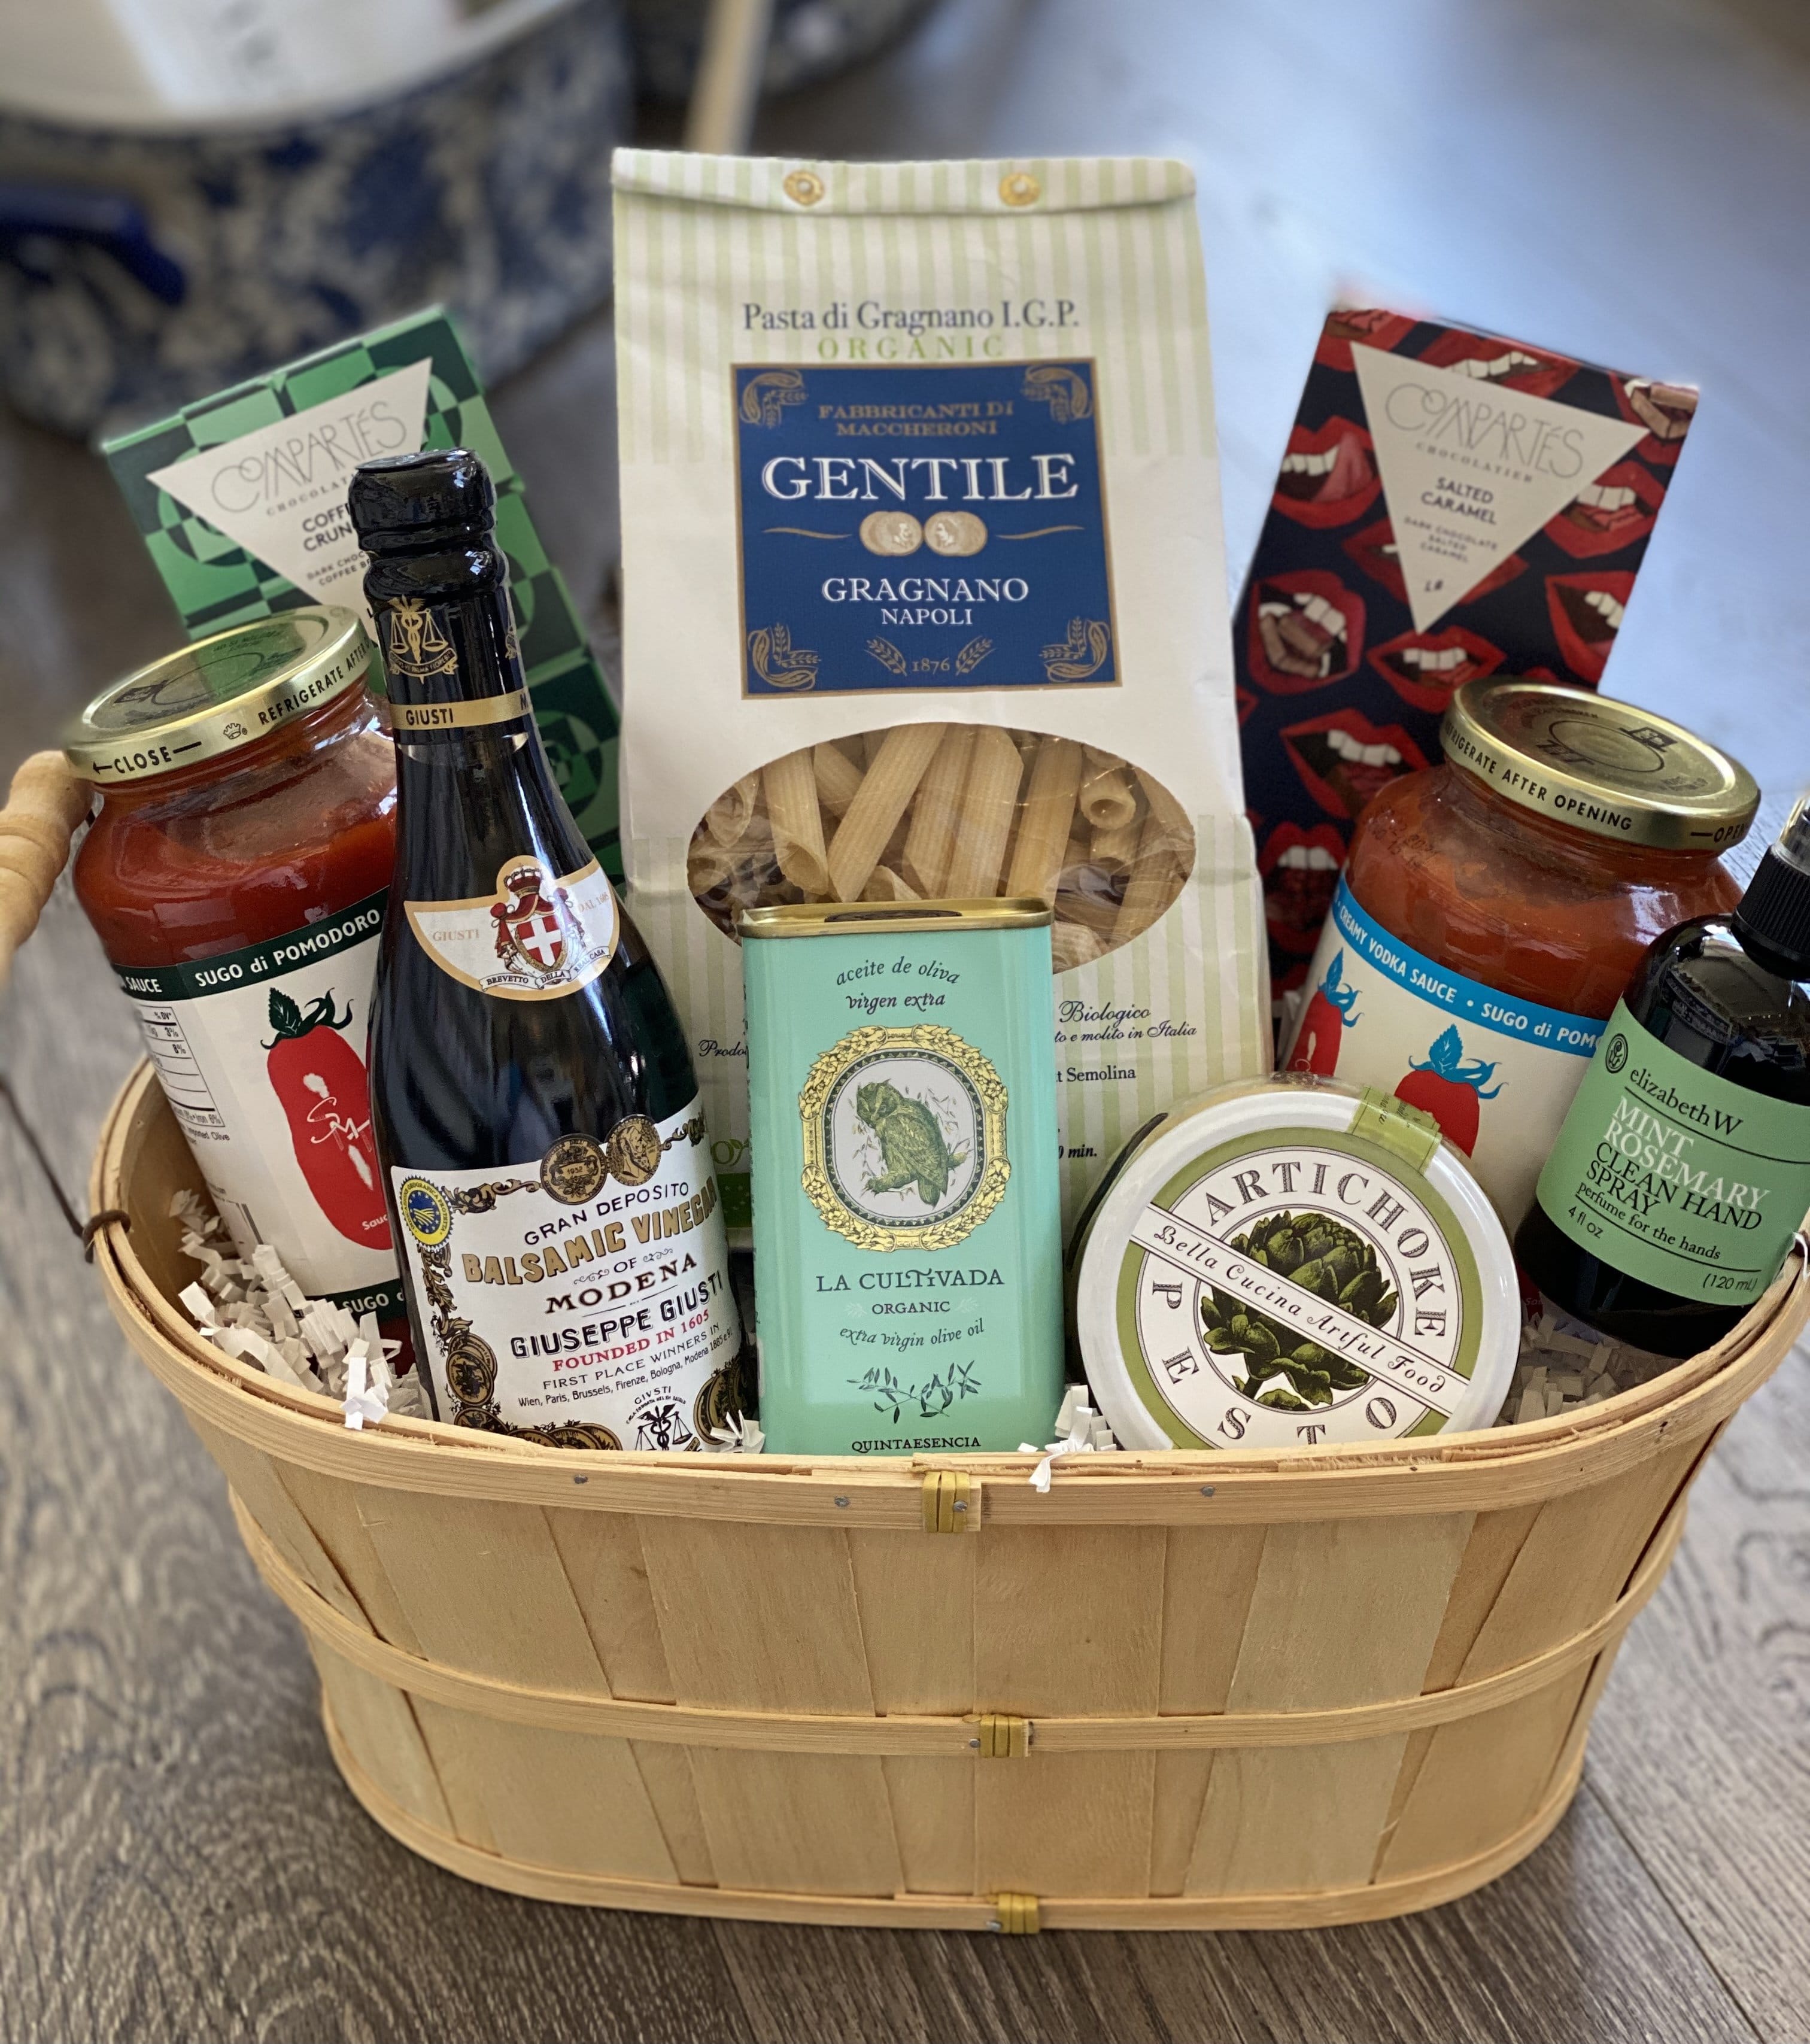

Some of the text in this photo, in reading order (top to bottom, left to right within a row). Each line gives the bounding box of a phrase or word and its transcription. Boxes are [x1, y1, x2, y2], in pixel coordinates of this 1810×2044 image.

[743, 300, 1080, 336] Pasta di Gragnano I.G.P.
[817, 335, 1003, 360] ORGANIC
[818, 403, 982, 420] FABBRICANTI
[836, 420, 998, 437] MACCHERONI
[761, 452, 1079, 500] GENTILE
[1415, 441, 1533, 484] CHOCOLATIER
[266, 474, 356, 517] CHOCOLAT
[1435, 476, 1494, 505] SALTED
[1420, 491, 1498, 526] CARAMEL
[306, 565, 334, 581] DARK
[318, 564, 358, 587] COFFEE
[821, 578, 1029, 602] GRAGNANO
[880, 608, 974, 626] NAPOLI
[911, 658, 952, 674] 1876
[257, 665, 345, 727] REFRIGERATE
[406, 708, 455, 726] GIUSTI
[113, 745, 173, 775] CLOSE
[1443, 720, 1497, 776] REFRIGERATE
[1501, 767, 1549, 801] AFTER
[1554, 794, 1633, 831] OPENING
[125, 909, 381, 993] SAUCE SUGO di POMODORO
[432, 928, 479, 943] GIUSTI
[486, 975, 530, 986] BREVETTO
[540, 970, 566, 983] DELLA
[589, 949, 606, 960] CASA
[836, 955, 961, 986] aceite de oliva
[1339, 904, 1368, 946] CREAMY
[1368, 940, 1407, 979] VODKA
[1409, 968, 1458, 1004] SAUCE
[1480, 1001, 1529, 1031] SUGO
[1533, 1022, 1552, 1039] di
[845, 992, 946, 1016] virgen extra
[1058, 1000, 1152, 1029] Biologico
[1080, 1025, 1125, 1042] molito
[1128, 1026, 1144, 1039] in
[1146, 1019, 1198, 1038] Italia
[698, 1038, 748, 1058] Prodo
[1066, 1064, 1137, 1083] Semolina
[210, 1131, 230, 1141] Olive
[1611, 1095, 1695, 1159] MINT
[1067, 1143, 1098, 1159] min.
[1603, 1118, 1771, 1211] ROSEMARY
[1586, 1159, 1661, 1217] SPRAY
[1596, 1142, 1762, 1231] CLEAN HAND
[524, 1181, 690, 1246] GRAN DEPOSITO
[1568, 1205, 1605, 1240] 4 fl oz
[1577, 1181, 1721, 1260] perfume for the hands
[461, 1221, 627, 1286] BALSAMIC
[613, 1256, 637, 1274] OF
[1204, 1161, 1449, 1340] ARTICHOKE
[544, 1252, 698, 1315] MODENA
[815, 1274, 852, 1292] LA
[1702, 1272, 1735, 1290] (120
[342, 1293, 390, 1314] SUGO
[510, 1307, 655, 1359] GIUSEPPE
[660, 1269, 723, 1323] GIUSTI
[871, 1301, 951, 1315] ORGANIC
[1153, 1223, 1447, 1395] Bella Cucina Artful Food
[552, 1308, 710, 1373] FOUNDED IN 1605
[839, 1317, 985, 1353] extra virgin olive oil
[542, 1322, 721, 1390] FIRST PLACE WINNERS IN
[518, 1397, 543, 1407] Wien,
[545, 1392, 570, 1404] Paris,
[572, 1385, 614, 1402] Brussels,
[615, 1375, 649, 1392] Firenze,
[650, 1360, 684, 1381] Bologna,
[684, 1347, 709, 1366] Modena
[634, 1386, 672, 1405] GIVSTI
[851, 1436, 982, 1454] QUINTAESENCIA
